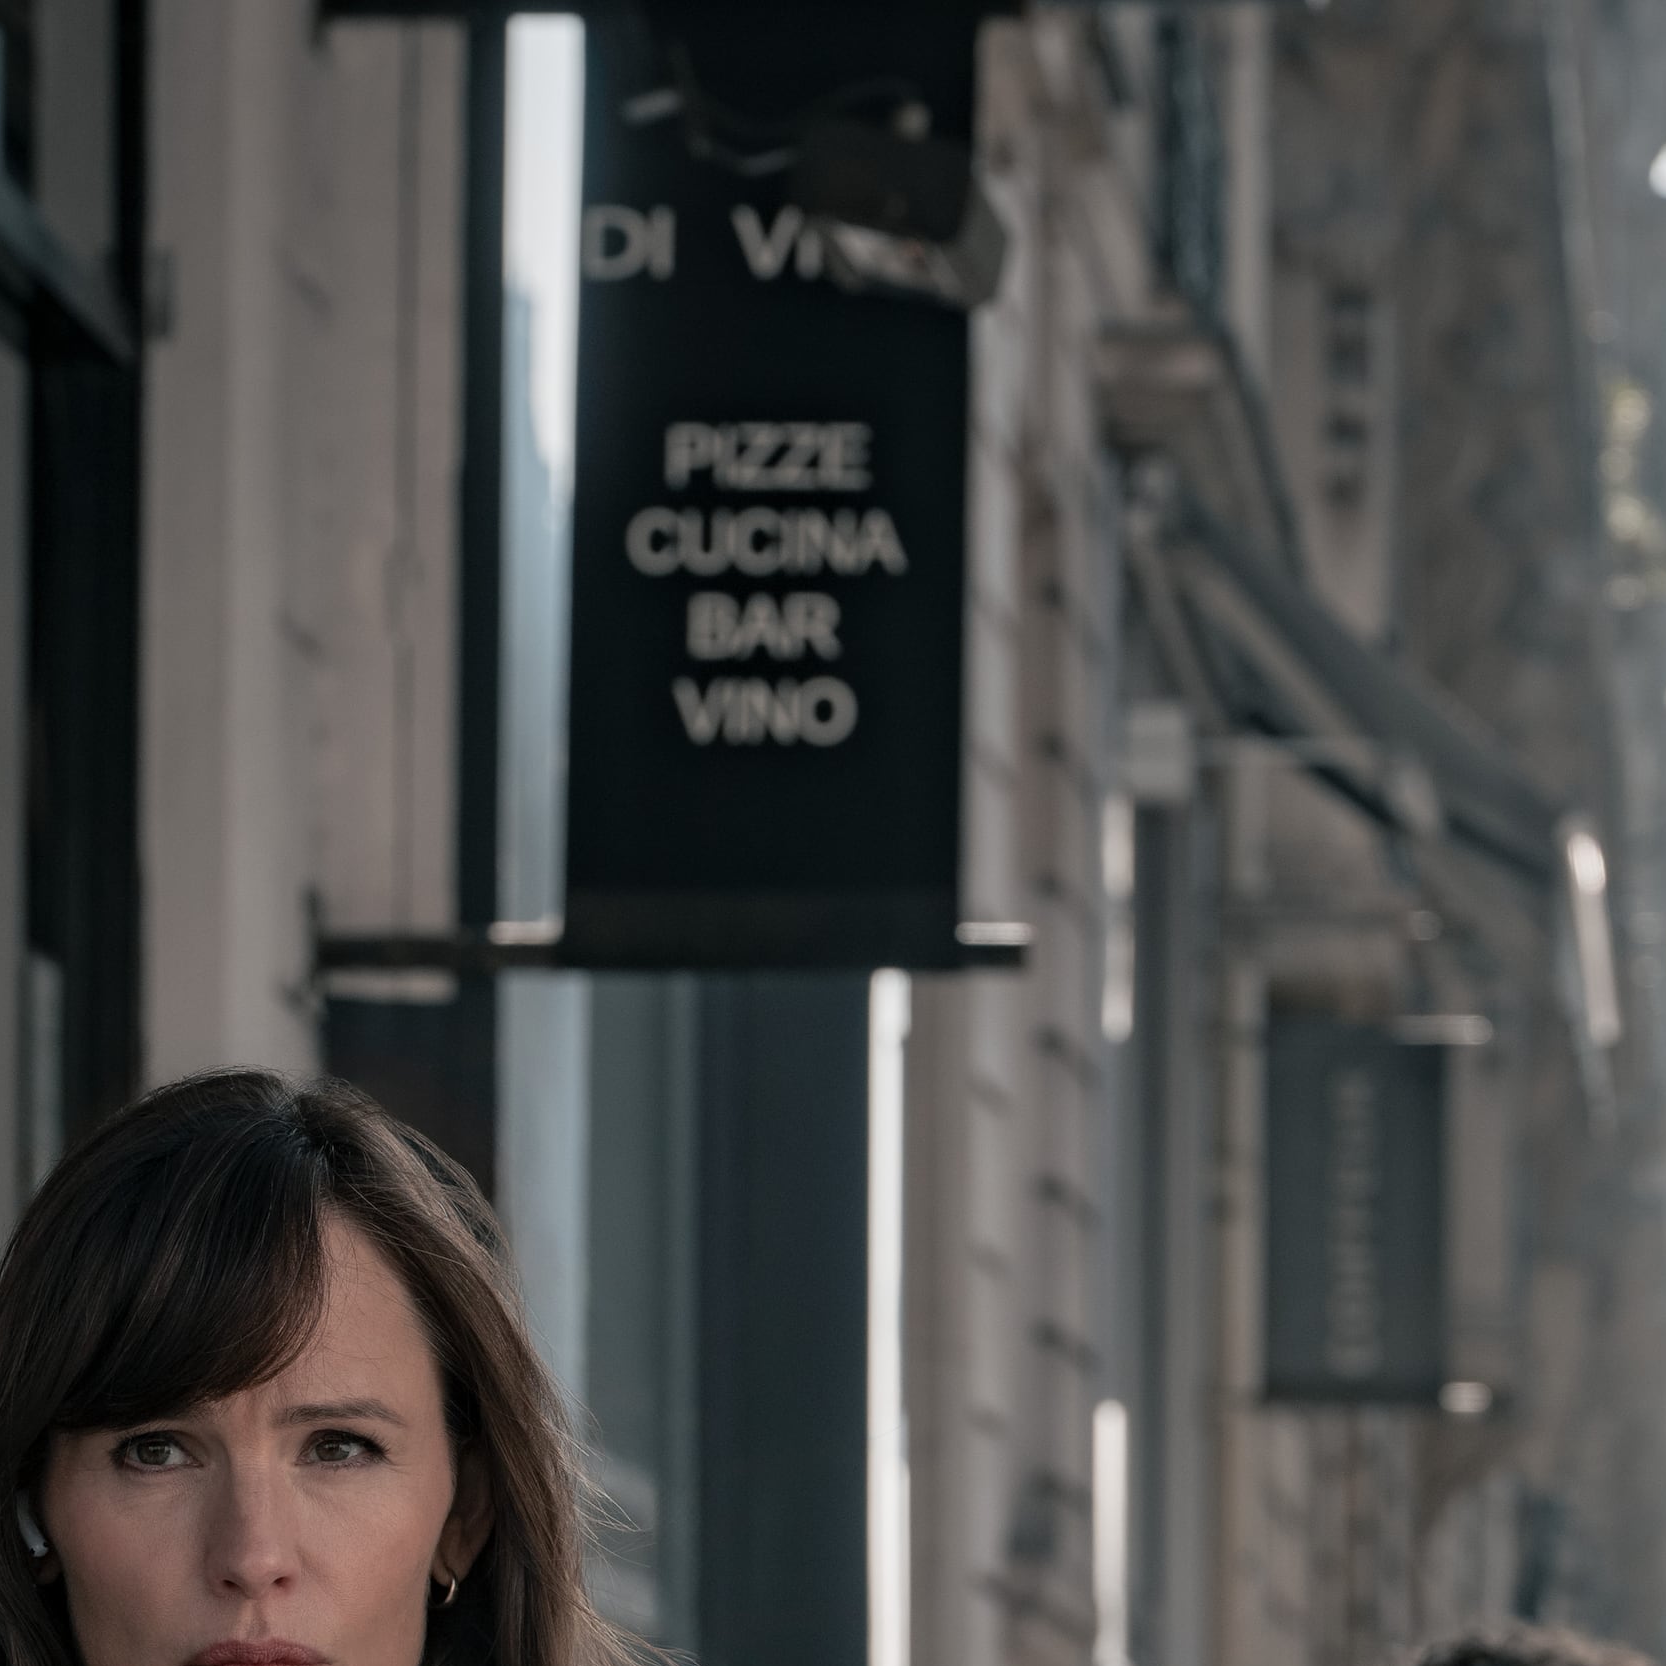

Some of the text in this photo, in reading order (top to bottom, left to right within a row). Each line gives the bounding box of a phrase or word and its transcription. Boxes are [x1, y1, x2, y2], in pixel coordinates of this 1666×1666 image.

[584, 205, 676, 282] DI
[664, 422, 871, 491] PIZZE
[625, 507, 909, 577] CUCINA
[686, 591, 841, 661] BAR
[672, 676, 859, 747] VINO
